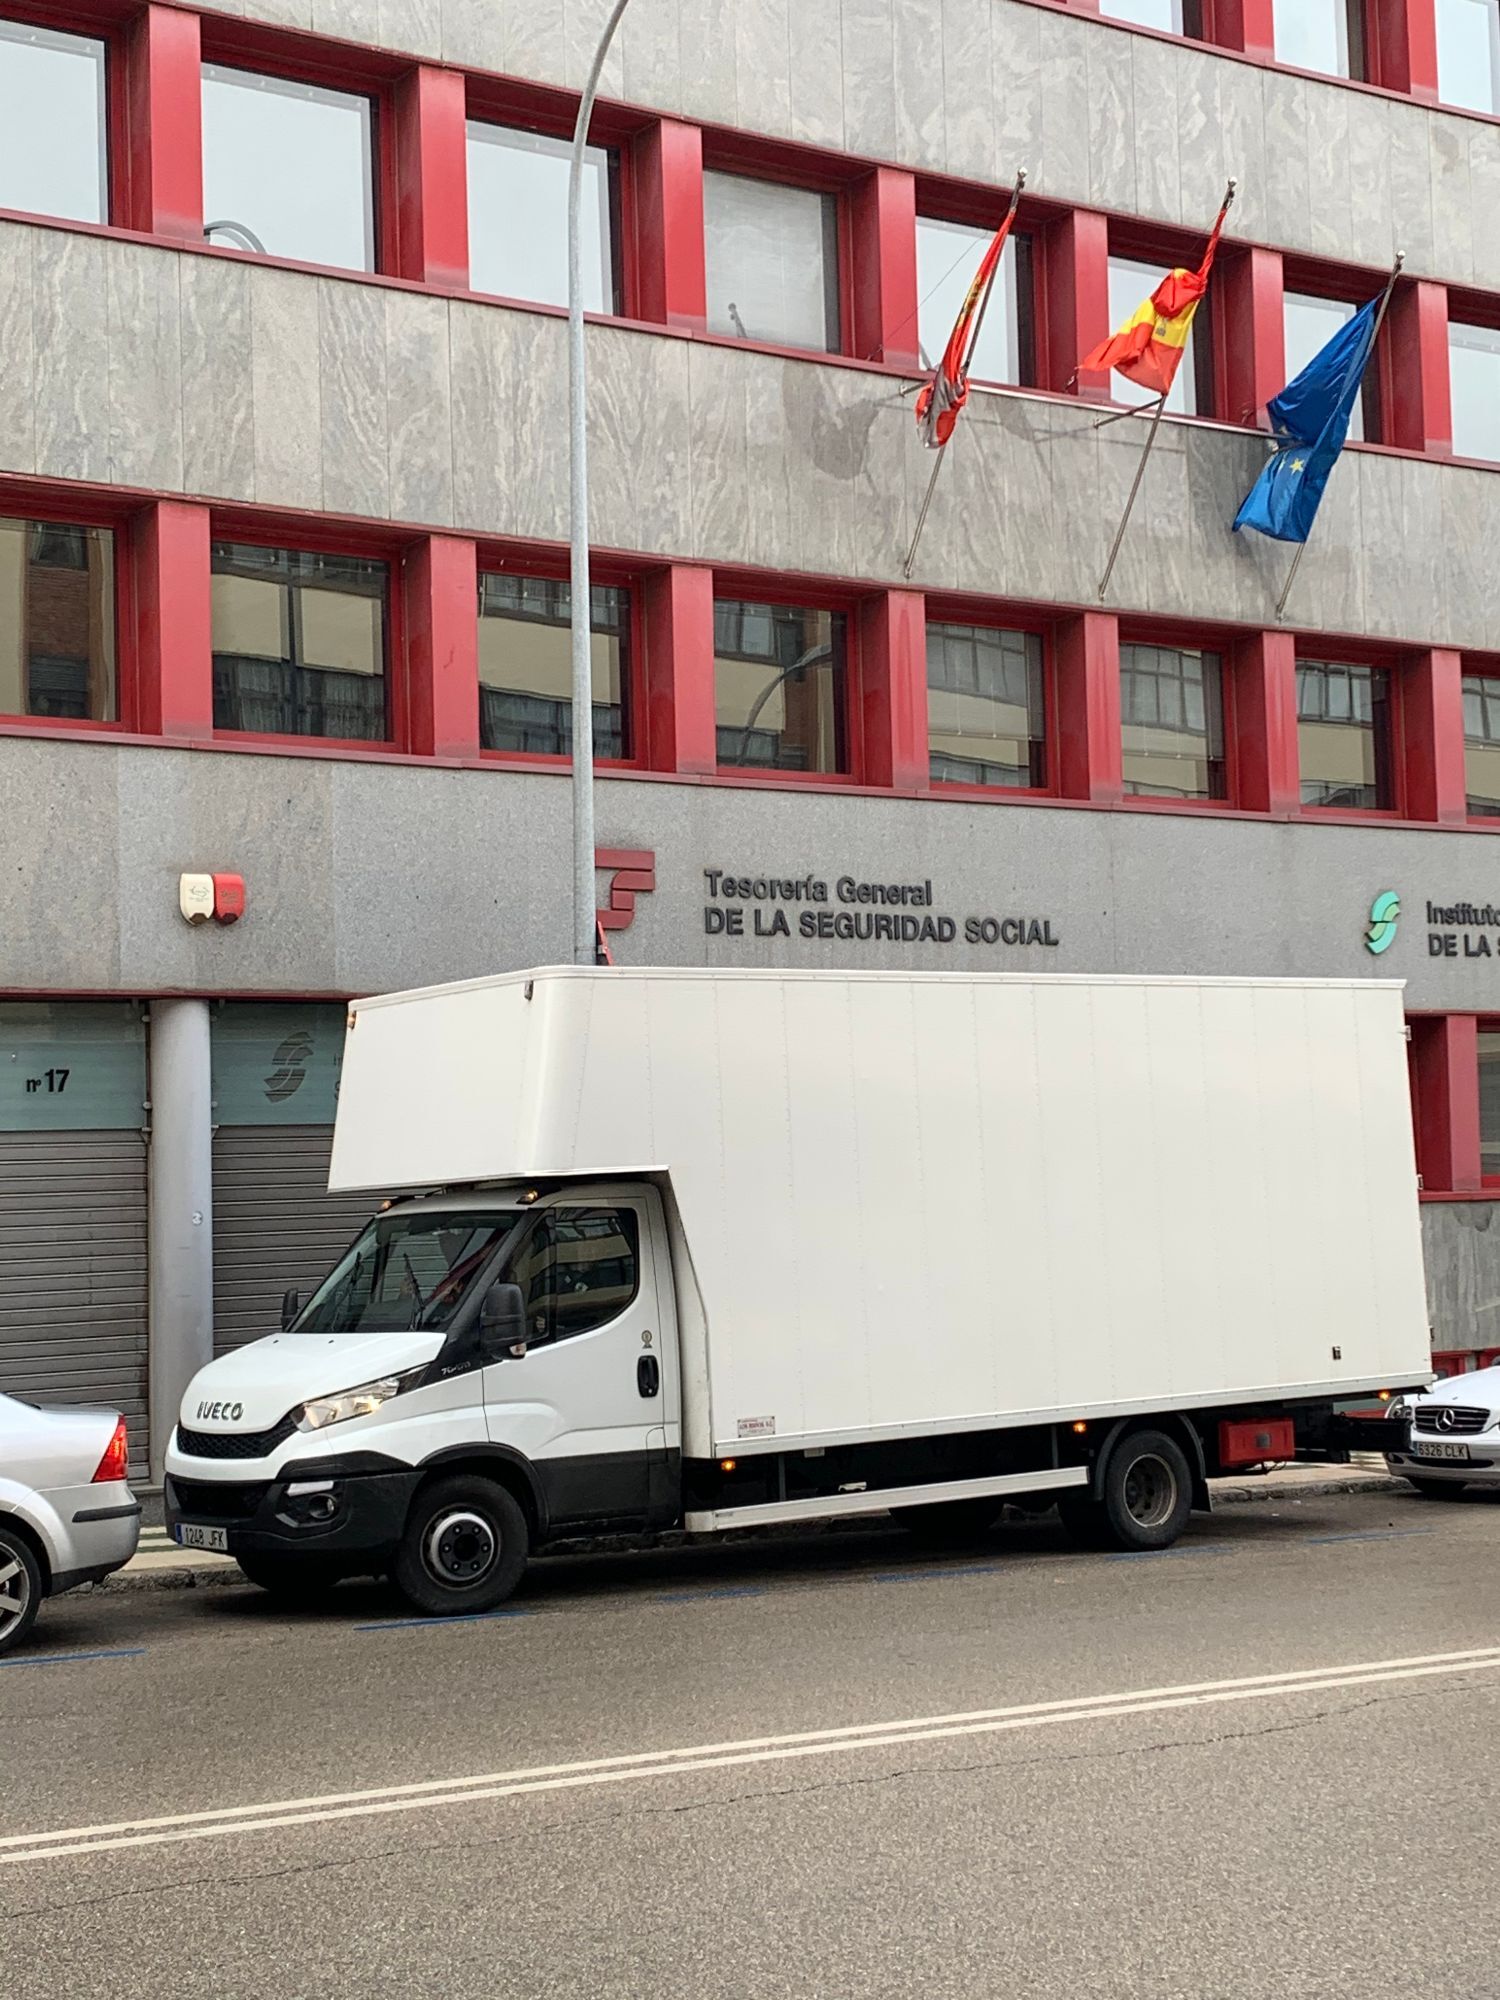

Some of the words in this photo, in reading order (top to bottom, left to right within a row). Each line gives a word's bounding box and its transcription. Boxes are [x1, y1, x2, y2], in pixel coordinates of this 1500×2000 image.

[704, 869, 828, 902] Tesorería
[836, 875, 932, 906] General
[704, 907, 744, 935] DE
[754, 909, 791, 937] LA
[799, 910, 957, 942] SEGURIDAD
[965, 917, 1059, 946] SOCIAL
[1428, 933, 1458, 957] DE
[1463, 934, 1492, 958] LA
[44, 1069, 70, 1093] 17
[196, 1401, 244, 1421] IVECO
[1445, 1444, 1465, 1458] CLK
[208, 1530, 225, 1548] JFK
